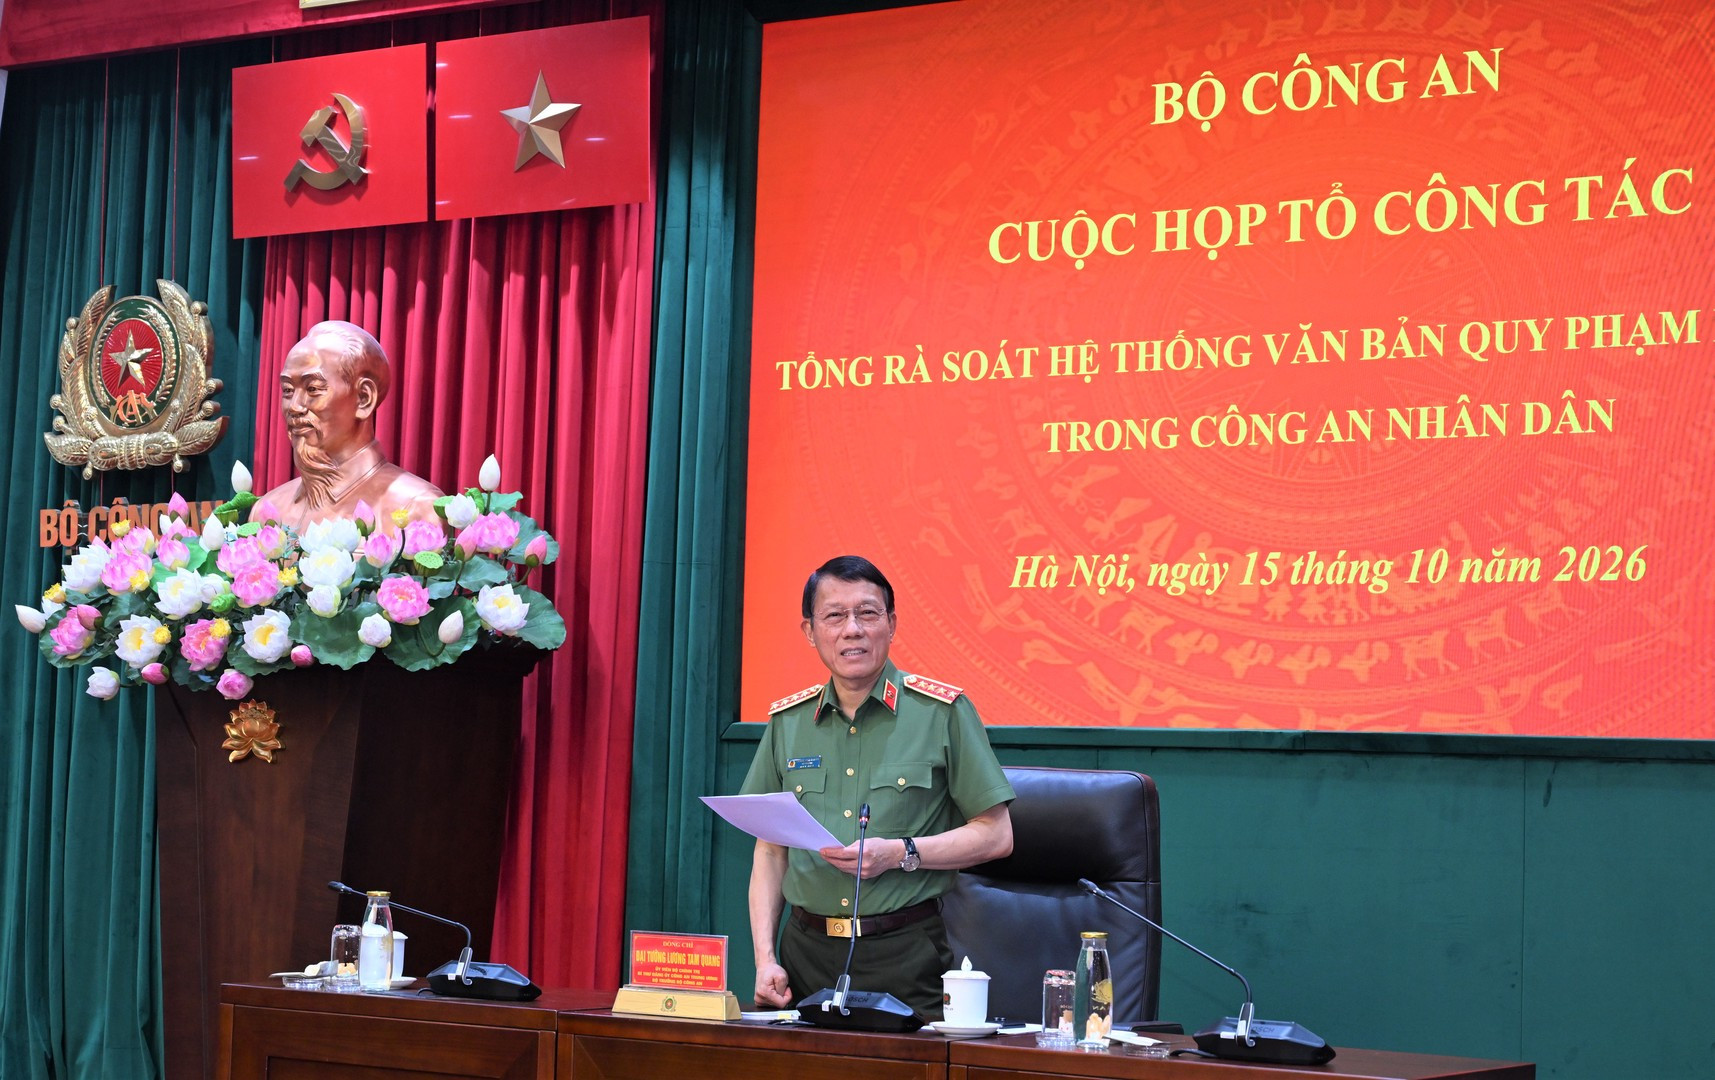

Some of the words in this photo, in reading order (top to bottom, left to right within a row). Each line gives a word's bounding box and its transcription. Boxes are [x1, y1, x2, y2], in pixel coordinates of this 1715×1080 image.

[1150, 70, 1226, 133] BỘ
[1241, 52, 1408, 115] CÔNG
[1419, 47, 1504, 99] AN
[988, 209, 1136, 271] CUỘC
[1151, 203, 1267, 261] HỌP
[1278, 182, 1357, 243] TỔ
[1373, 172, 1549, 236] CÔNG
[1564, 157, 1693, 221] TÁC
[775, 351, 874, 391] TỔNG
[882, 344, 933, 385] RÀ
[942, 339, 1039, 383] SOÁT
[1048, 339, 1100, 384] HỆ
[1110, 329, 1253, 373] THỐNG
[1262, 322, 1349, 365] VĂN
[1359, 315, 1447, 361] BẢN
[1459, 317, 1554, 362] QUY
[1564, 309, 1701, 356] PHẠM
[1042, 416, 1180, 453] TRONG
[1190, 404, 1308, 448] CÔNG
[1315, 408, 1374, 443] AN
[1385, 394, 1510, 441] NHÂN
[1521, 389, 1617, 436] DÂN
[39, 500, 79, 555] BỘ
[1008, 554, 1059, 589] Hà
[1067, 553, 1135, 596] Nội,
[1147, 551, 1230, 596] ngày
[1239, 551, 1282, 586] 15
[1290, 549, 1395, 595] tháng
[1405, 547, 1449, 584] 10
[1458, 547, 1542, 584] năm
[1552, 544, 1648, 582] 2026
[701, 954, 720, 968] QUANG
